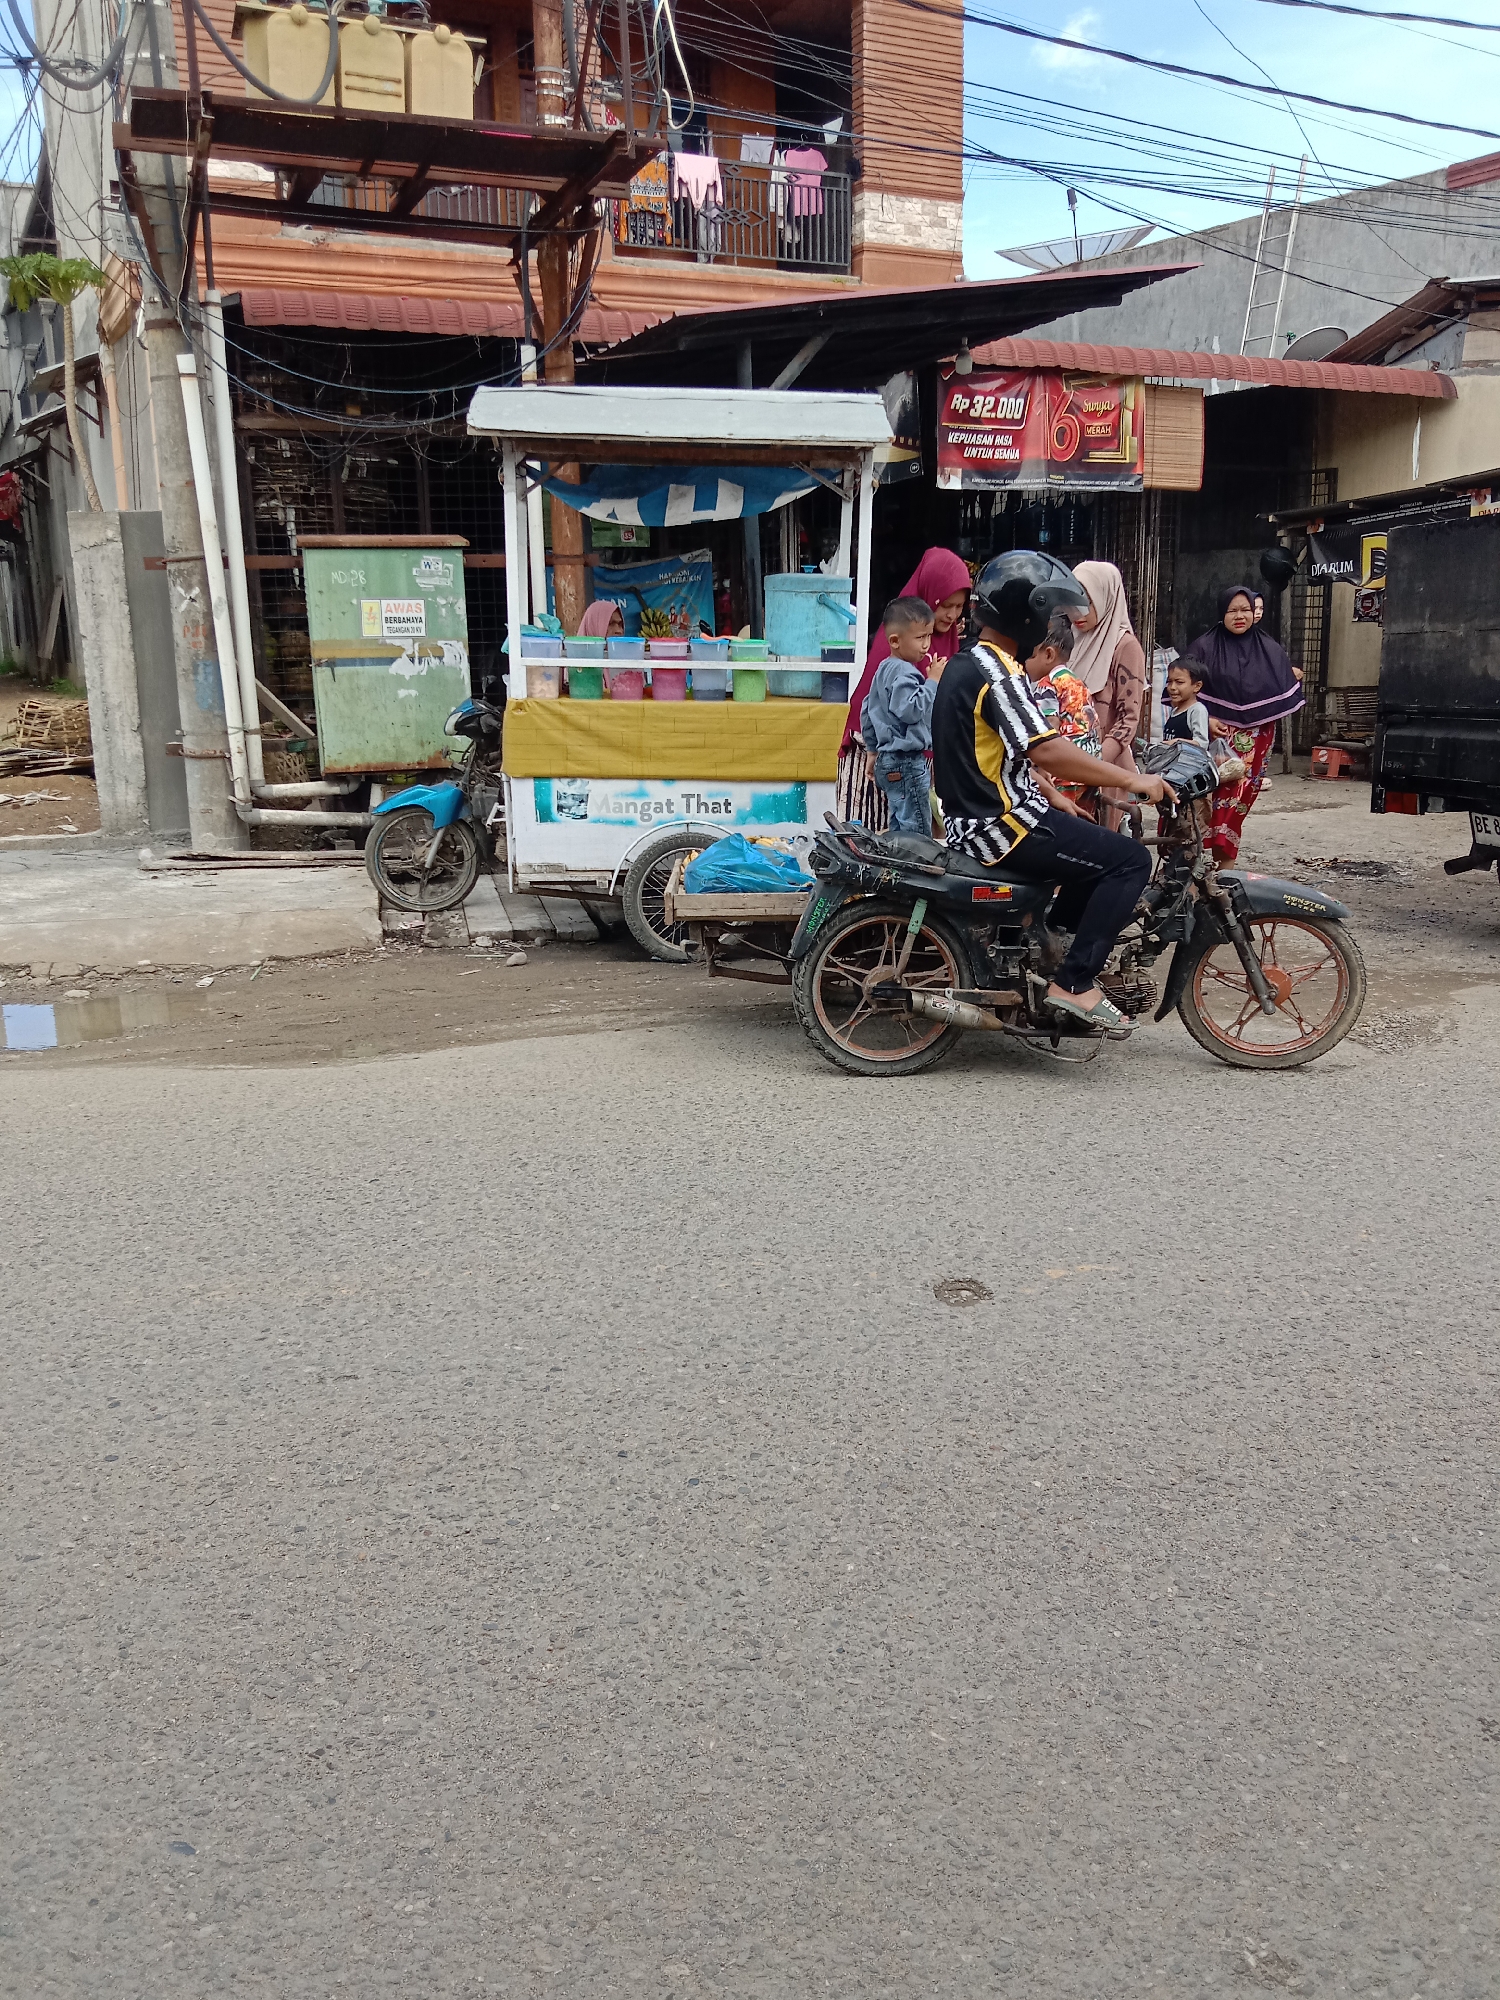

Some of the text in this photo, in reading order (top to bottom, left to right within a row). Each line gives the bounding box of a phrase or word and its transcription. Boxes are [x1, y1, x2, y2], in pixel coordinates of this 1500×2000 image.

[951, 394, 1025, 420] Rp 32.000
[1083, 399, 1114, 417] Surya
[1086, 425, 1111, 435] MERAH
[948, 431, 1013, 446] KEPUASAN RASA
[963, 447, 1020, 460] UNTUK SEMUA
[1311, 560, 1354, 577] DJARUM
[384, 602, 423, 614] AWAS
[384, 616, 424, 624] BERBAHAYA
[386, 626, 410, 634] TEGANGAN
[591, 793, 732, 822] Mangat That
[1474, 815, 1491, 834] BE
